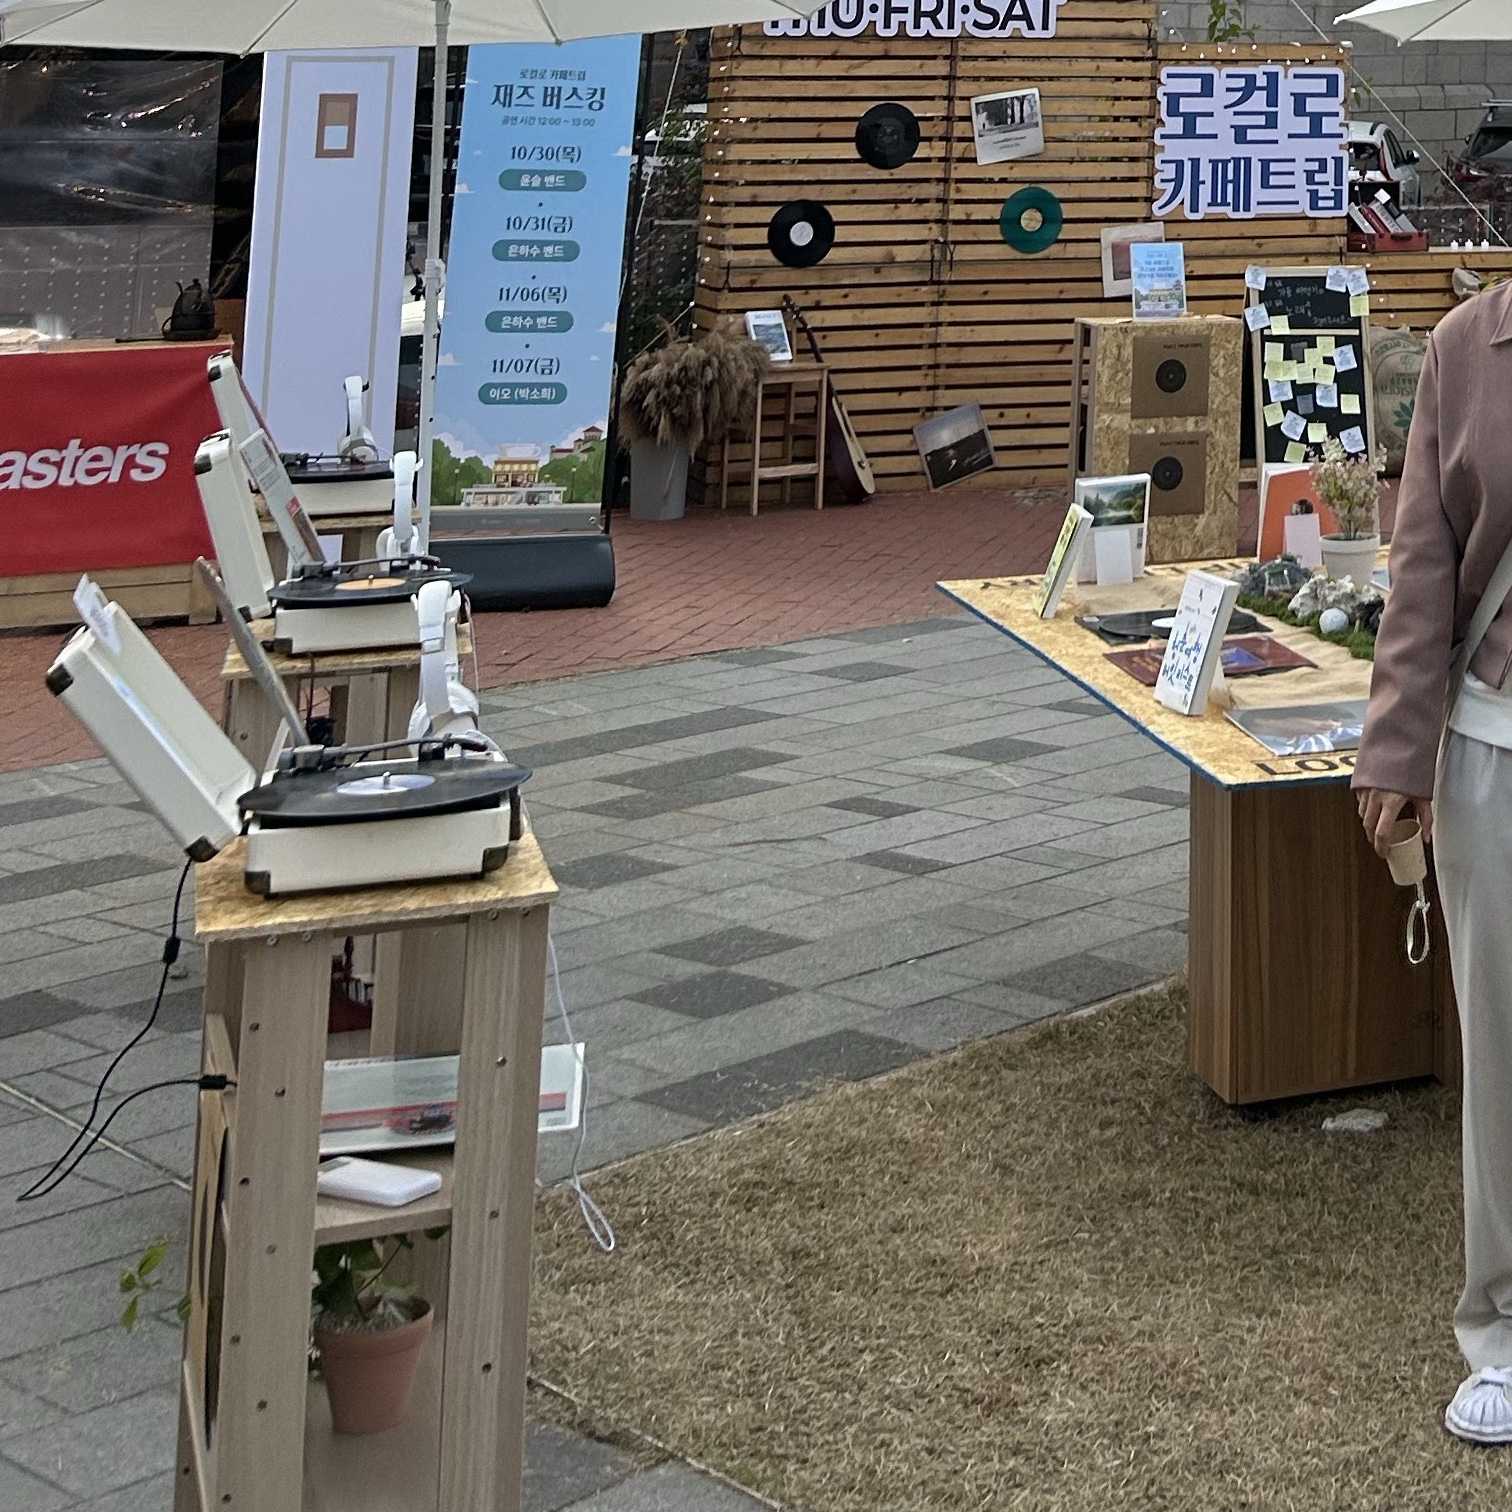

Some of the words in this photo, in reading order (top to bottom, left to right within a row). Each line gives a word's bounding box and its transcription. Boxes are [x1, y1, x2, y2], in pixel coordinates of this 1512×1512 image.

[519, 68, 547, 80] 로컬로
[549, 69, 587, 81] 카페트립
[491, 84, 536, 108] 재즈
[541, 86, 606, 111] 버스킹
[1160, 71, 1343, 144] 로컬로
[511, 146, 582, 163] 10/30(목)
[1158, 157, 1343, 213] 카페트립
[506, 216, 573, 233] 10/31(금)
[508, 245, 540, 257] 은하수
[499, 286, 567, 304] 11/06(목)
[501, 316, 533, 328] 은하수
[492, 357, 560, 375] 11/07(금)
[0, 439, 170, 489] asters
